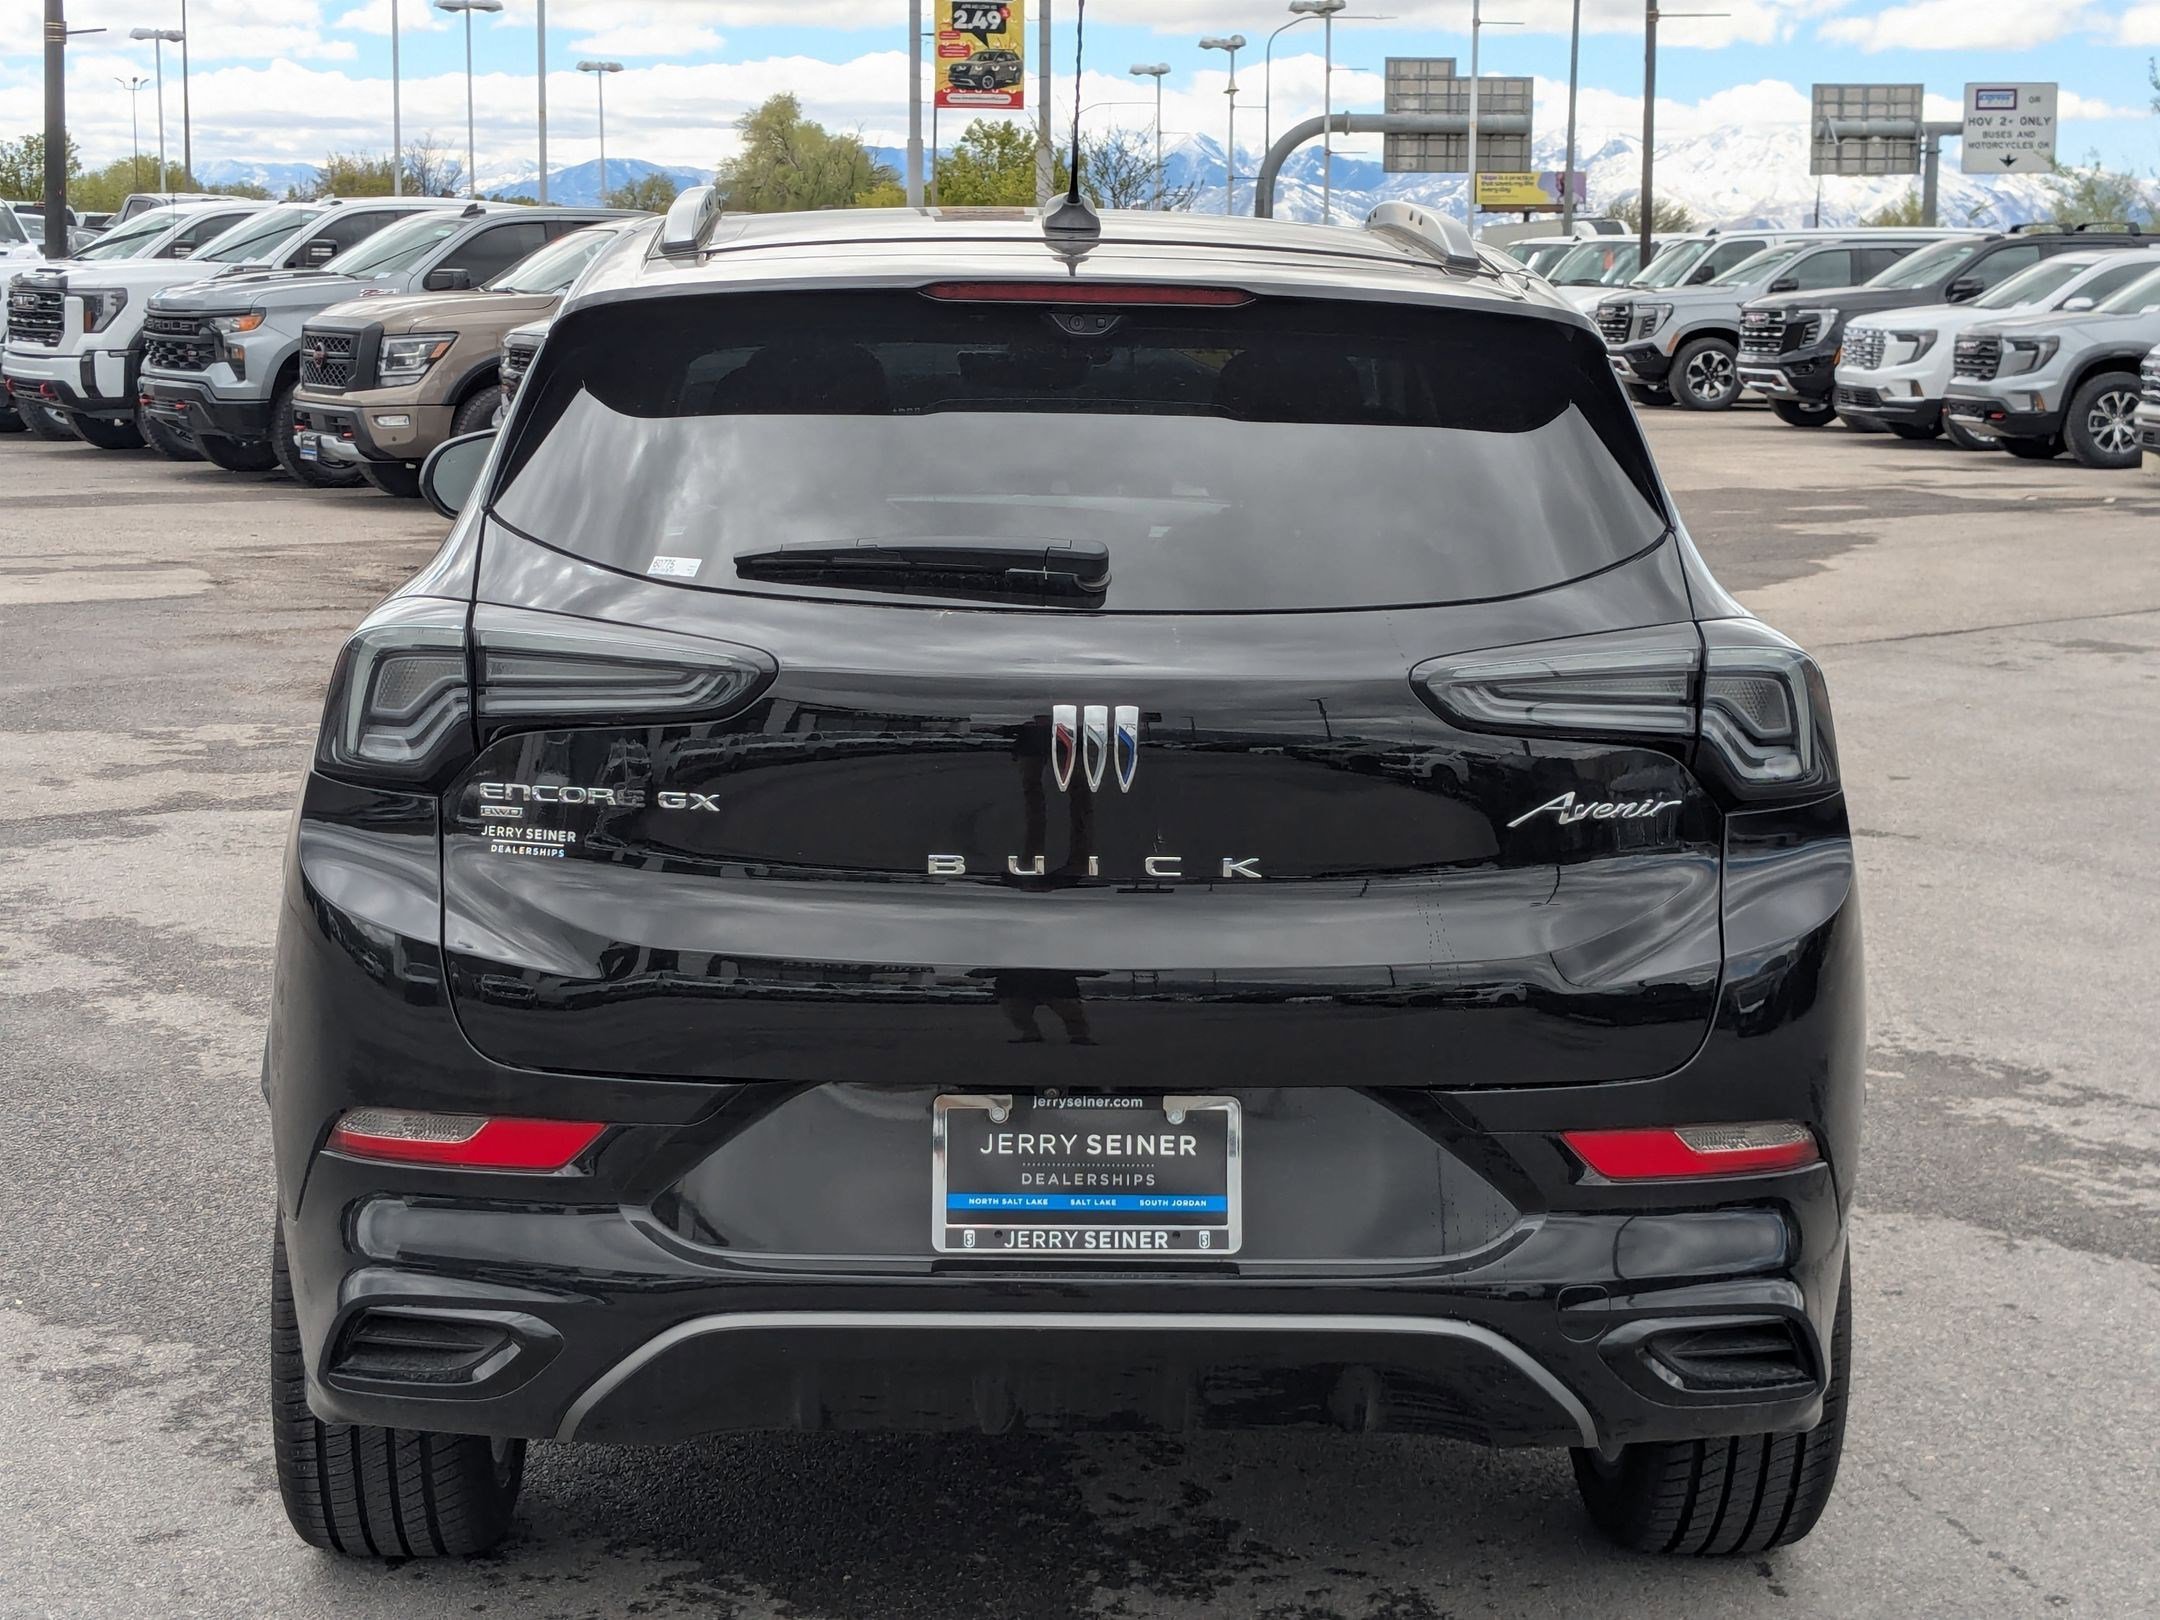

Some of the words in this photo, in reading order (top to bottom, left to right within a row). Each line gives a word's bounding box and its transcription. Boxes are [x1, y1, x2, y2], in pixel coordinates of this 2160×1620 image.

[953, 9, 1001, 29] 2.49
[1967, 117, 1993, 126] HOV
[2020, 117, 2052, 126] ONLY
[1982, 131, 2013, 139] BUSES
[1968, 142, 2034, 150] MOTORCYCLES
[479, 782, 647, 808] ENCORE
[657, 791, 721, 812] GX
[1506, 791, 1682, 828] Avenir
[481, 825, 524, 839] JERRY
[525, 828, 576, 843] SEINER
[490, 845, 565, 858] DEALERSHIPS
[928, 854, 1262, 878] BUICK
[1032, 1095, 1143, 1110] jerryseiner.com
[980, 1133, 1077, 1155] JERRY
[1086, 1134, 1197, 1156] SEINER
[1021, 1173, 1156, 1187] DEALERSHIPS
[1025, 1198, 1048, 1206] LAKE
[1004, 1230, 1078, 1248] JERRY
[1084, 1231, 1169, 1249] SEINER
